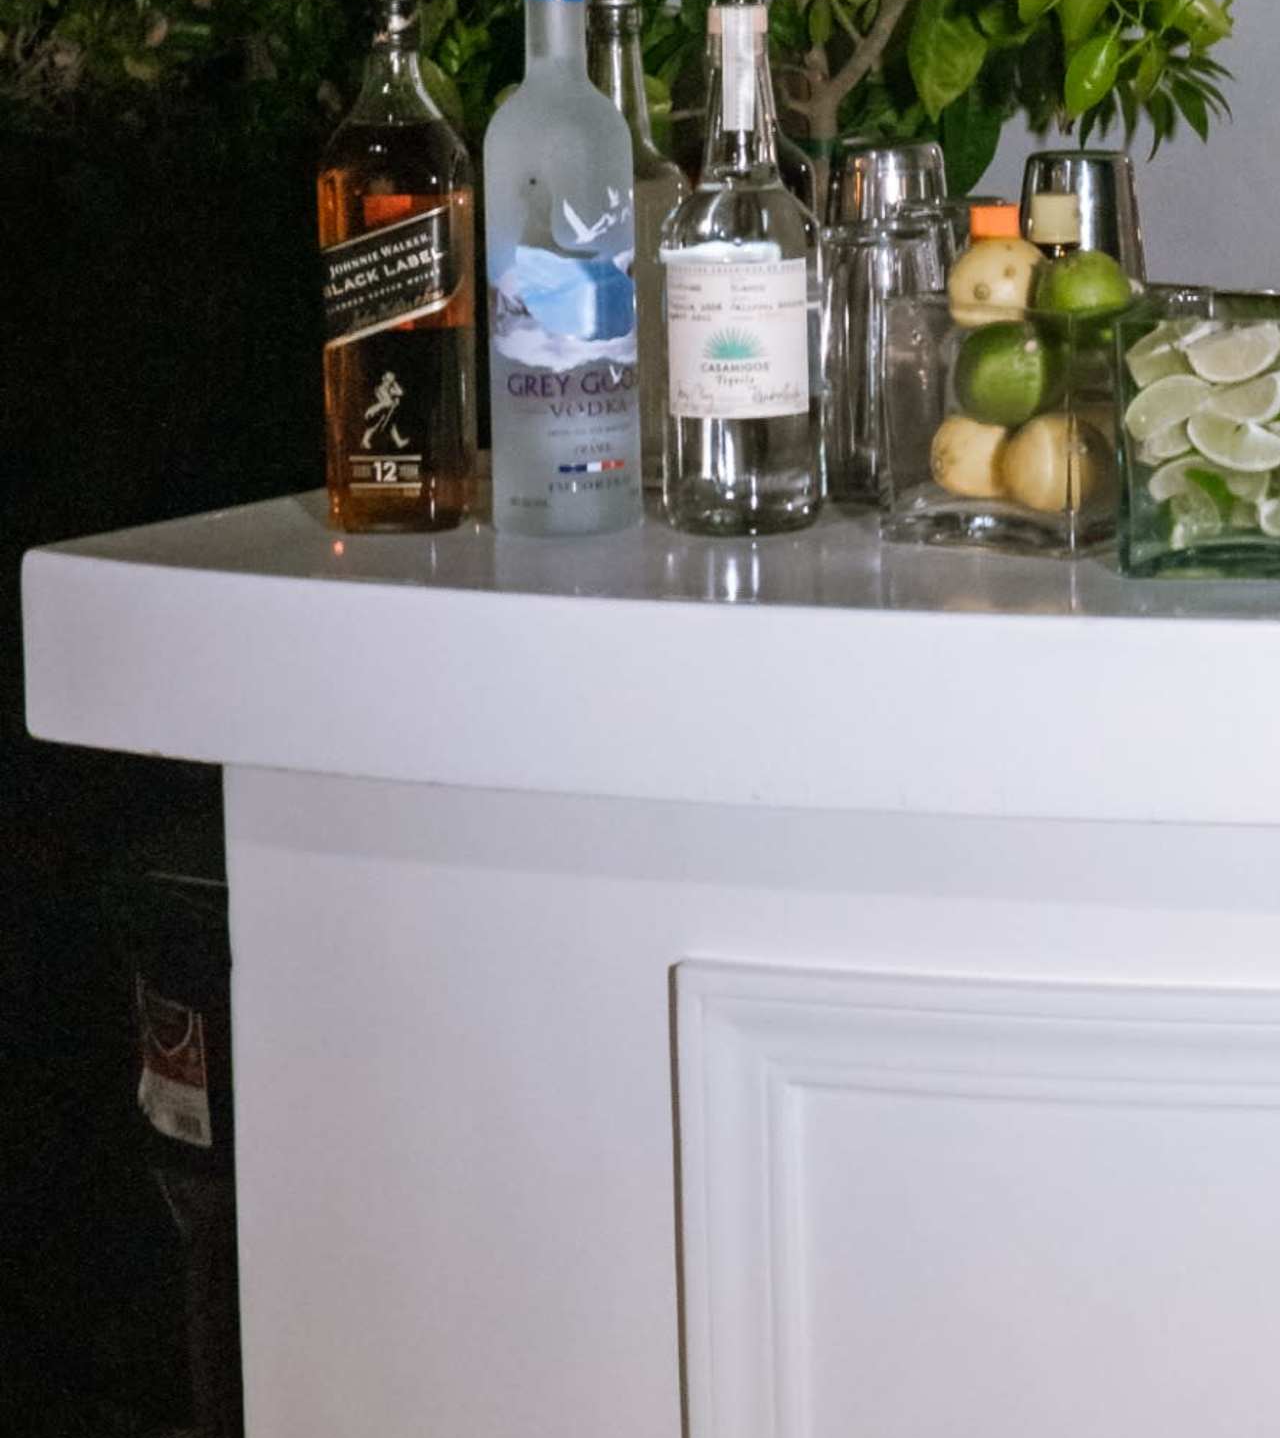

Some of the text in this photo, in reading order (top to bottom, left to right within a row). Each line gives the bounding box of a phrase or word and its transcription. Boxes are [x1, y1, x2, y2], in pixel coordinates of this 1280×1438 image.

[328, 250, 379, 279] JOHNNIE
[383, 247, 444, 277] LABEL
[507, 366, 639, 398] GREY GOO
[373, 460, 398, 483] 12
